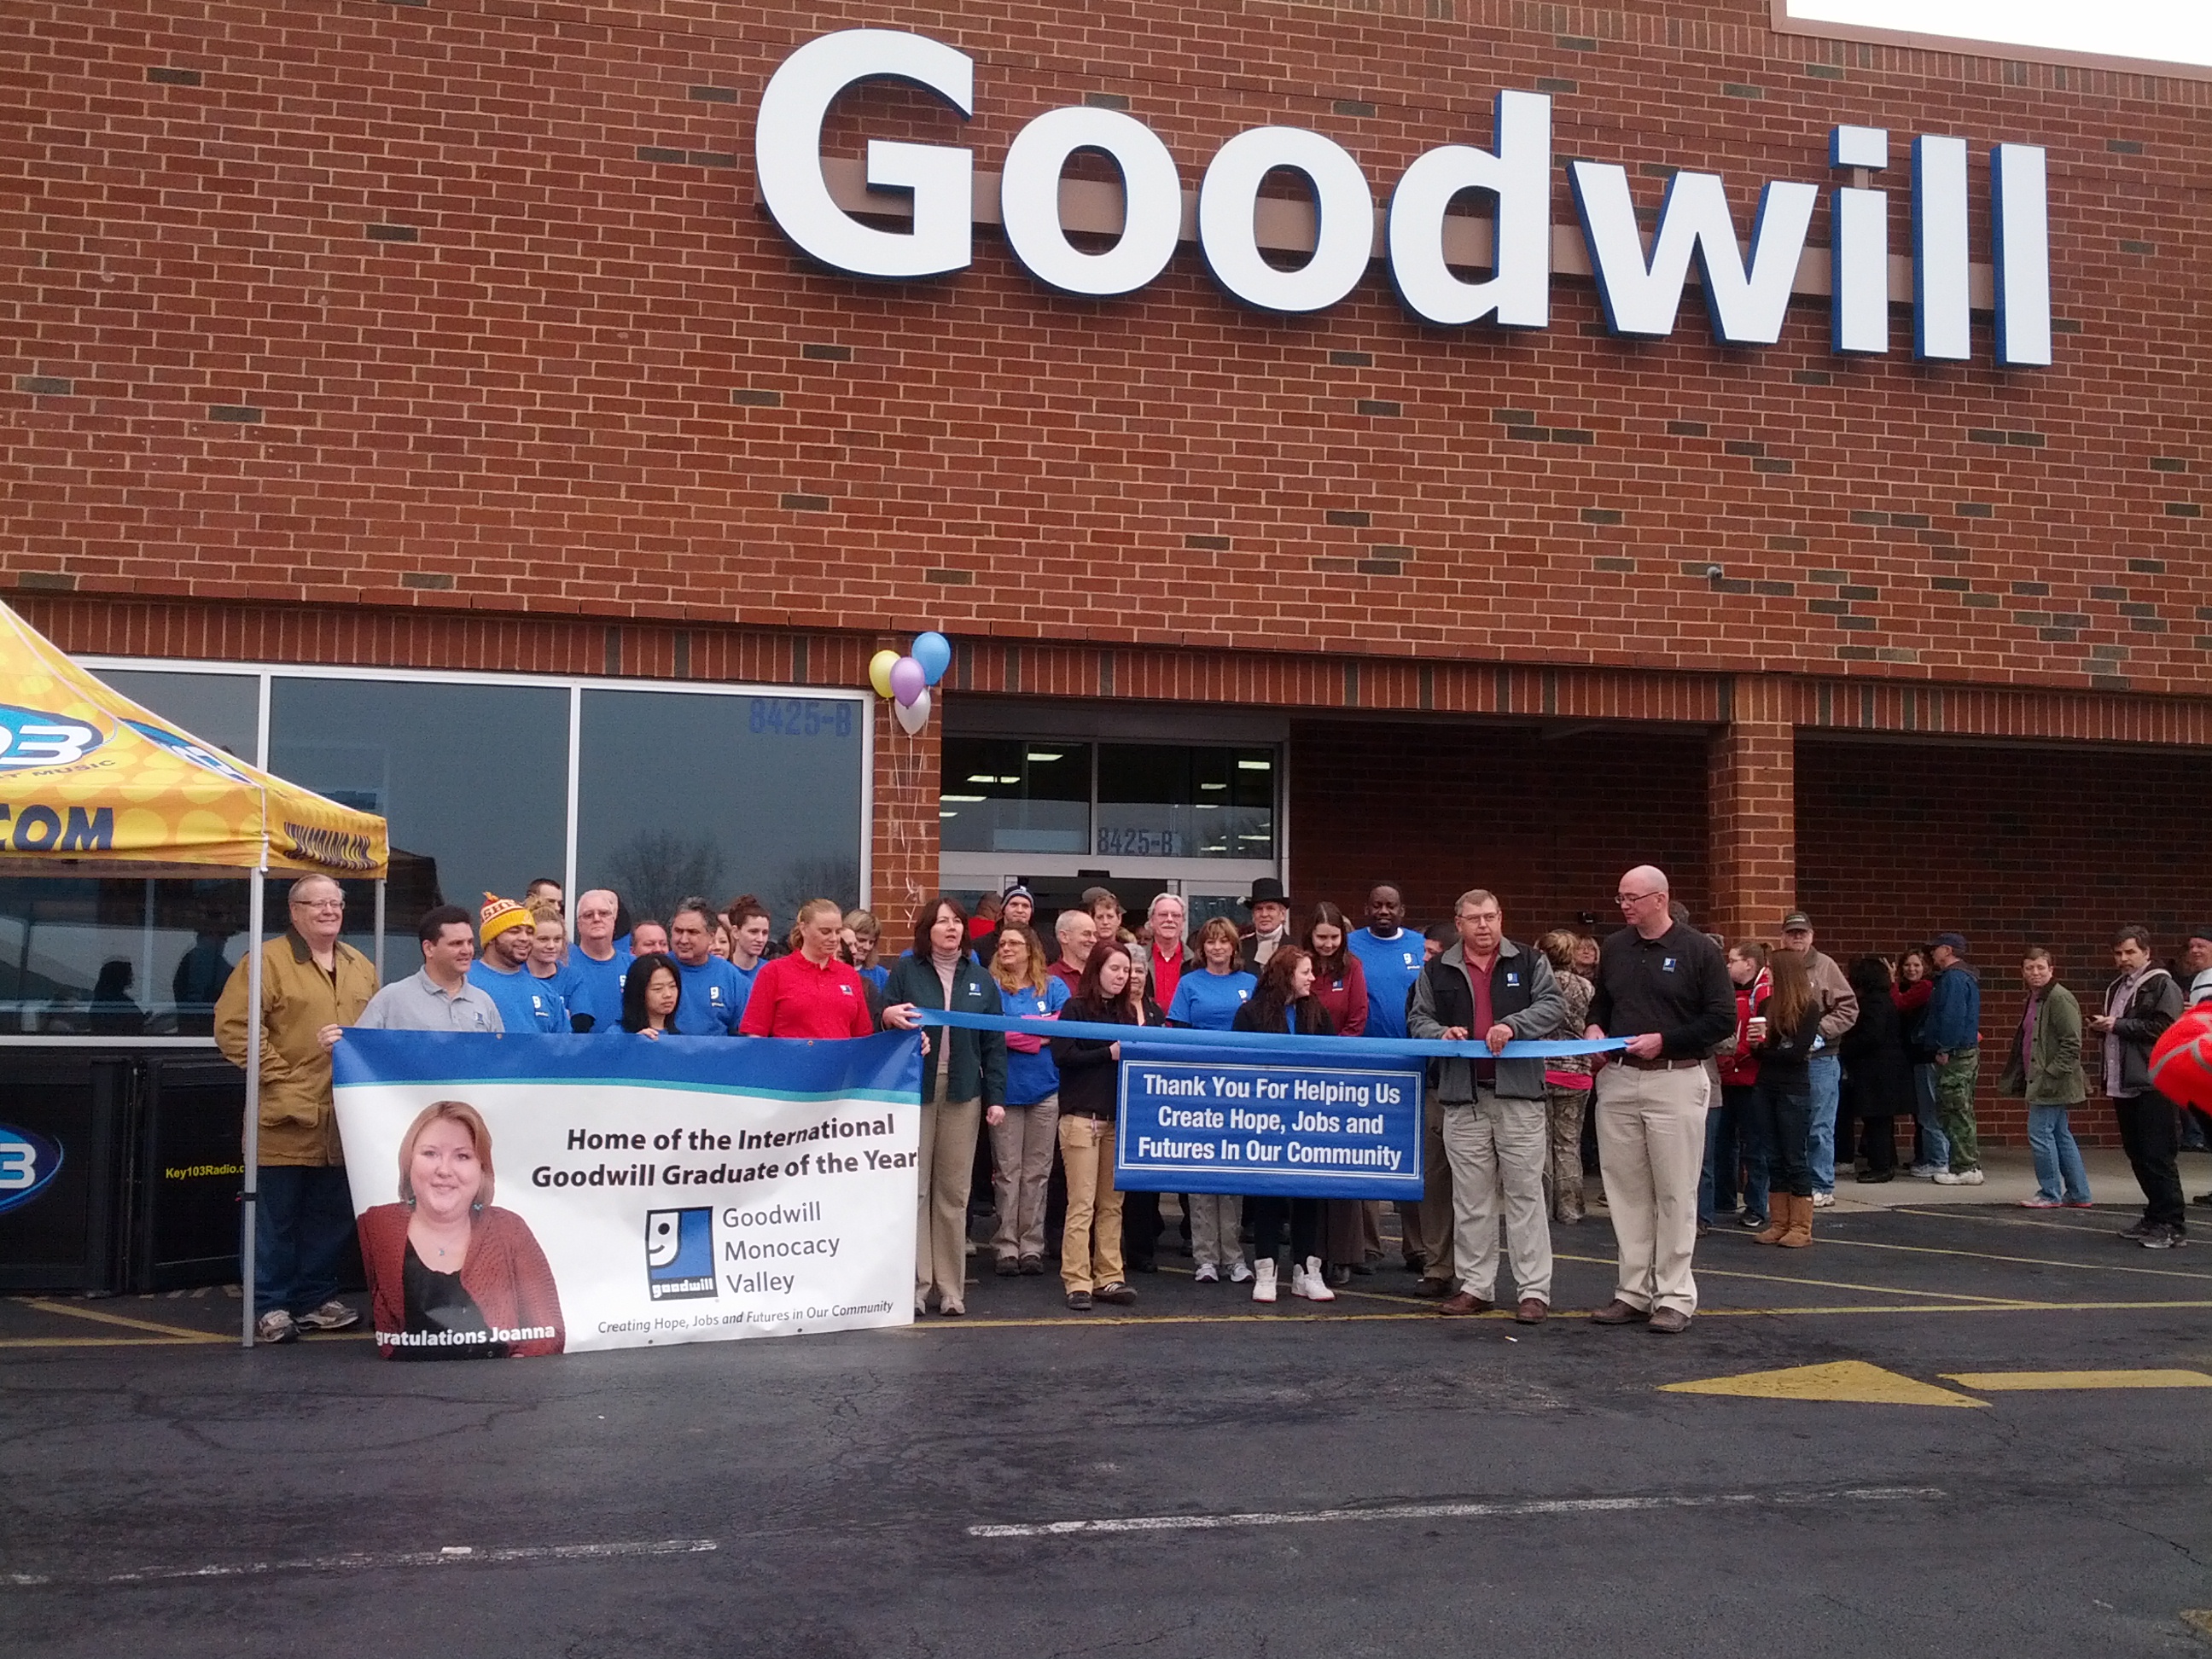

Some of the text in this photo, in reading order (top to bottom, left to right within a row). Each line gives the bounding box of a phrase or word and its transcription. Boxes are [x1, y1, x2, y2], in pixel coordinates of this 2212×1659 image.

[755, 28, 2050, 366] Goodwill
[749, 699, 853, 736] 8425-B
[32, 760, 116, 777] MUSIC
[1097, 827, 1173, 856] 8425-B
[1143, 1074, 1400, 1107] Thank You For Helping Us
[567, 1114, 894, 1150] Home of the International
[1158, 1106, 1383, 1135] Create Hope, Jobs and
[1138, 1137, 1401, 1171] Futures In Our Community
[532, 1165, 655, 1188] Goodwill
[661, 1163, 779, 1185] Graduate
[784, 1154, 811, 1177] of
[815, 1152, 859, 1175] the
[723, 1201, 821, 1228] Goodwill
[725, 1237, 840, 1261] Monocacy
[651, 1278, 713, 1298] goodwill
[725, 1272, 795, 1294] Valley
[598, 1301, 894, 1334] Creating Hope, Jobs and Futures in Our Community
[489, 1325, 555, 1342] Joanna
